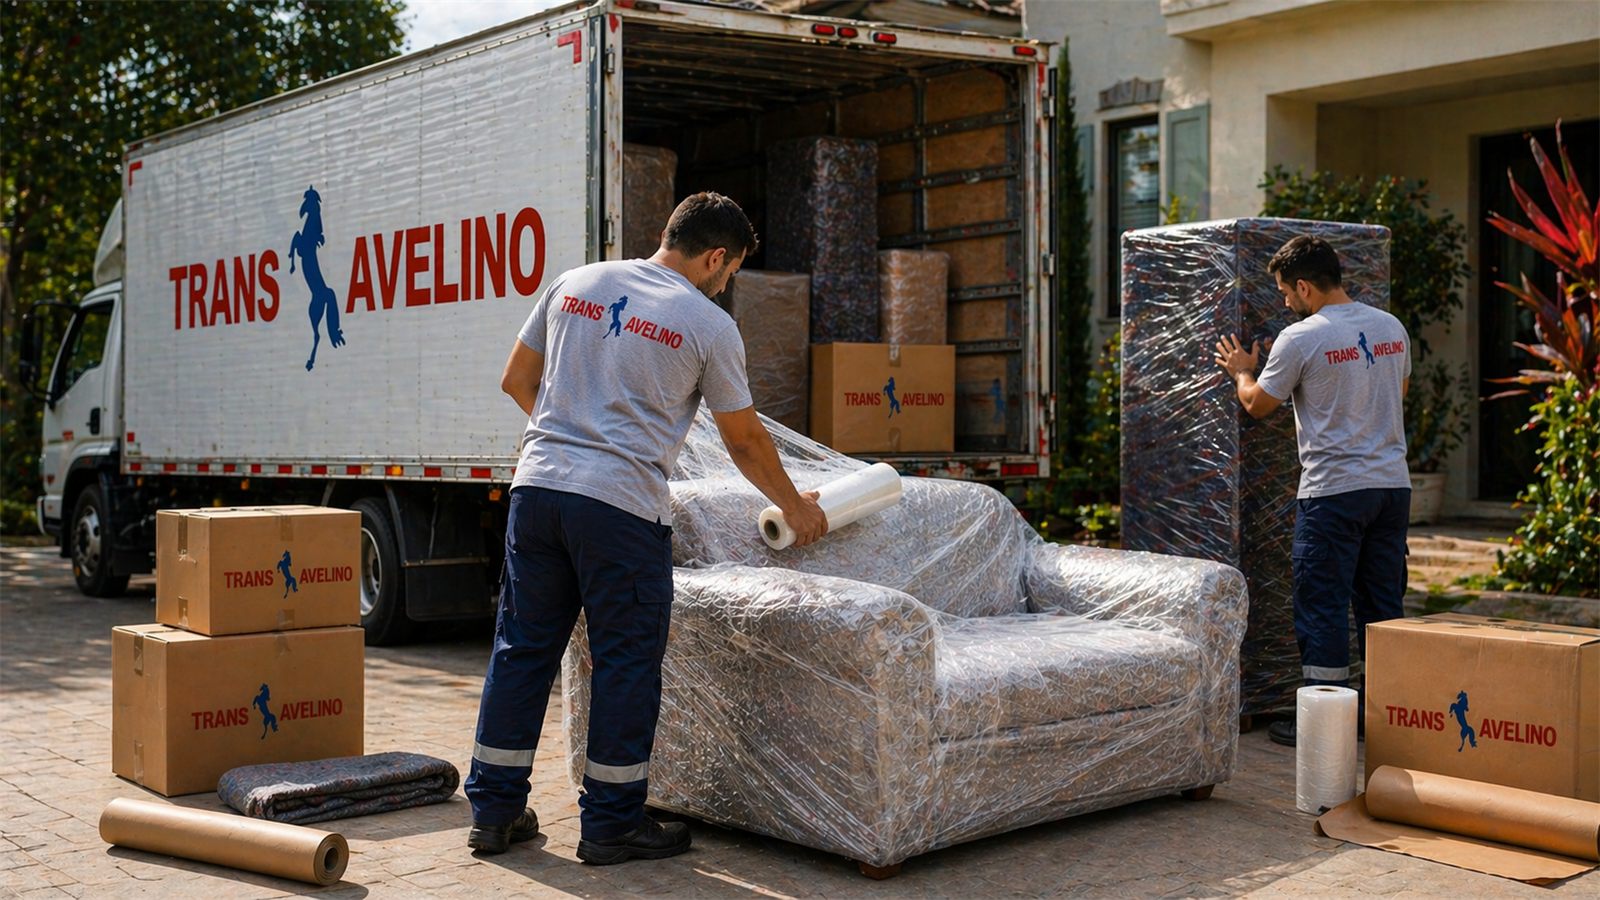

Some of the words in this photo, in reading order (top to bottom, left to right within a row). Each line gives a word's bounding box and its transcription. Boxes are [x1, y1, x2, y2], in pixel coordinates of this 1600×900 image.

[169, 249, 280, 330] TRANS
[345, 206, 546, 314] AVELINO
[561, 295, 606, 321] TRANS
[624, 316, 683, 350] AVELINO
[1325, 346, 1360, 365] TRANS
[1373, 340, 1405, 357] AVELINO
[844, 391, 882, 407] TRANS
[901, 392, 945, 408] AVELINO
[223, 570, 274, 589] TRANS
[298, 565, 353, 584] AVELINO
[191, 706, 249, 731] TRANS
[279, 697, 344, 720] AVELINO
[1386, 704, 1446, 732] TRANS
[1479, 718, 1558, 748] AVELINO
